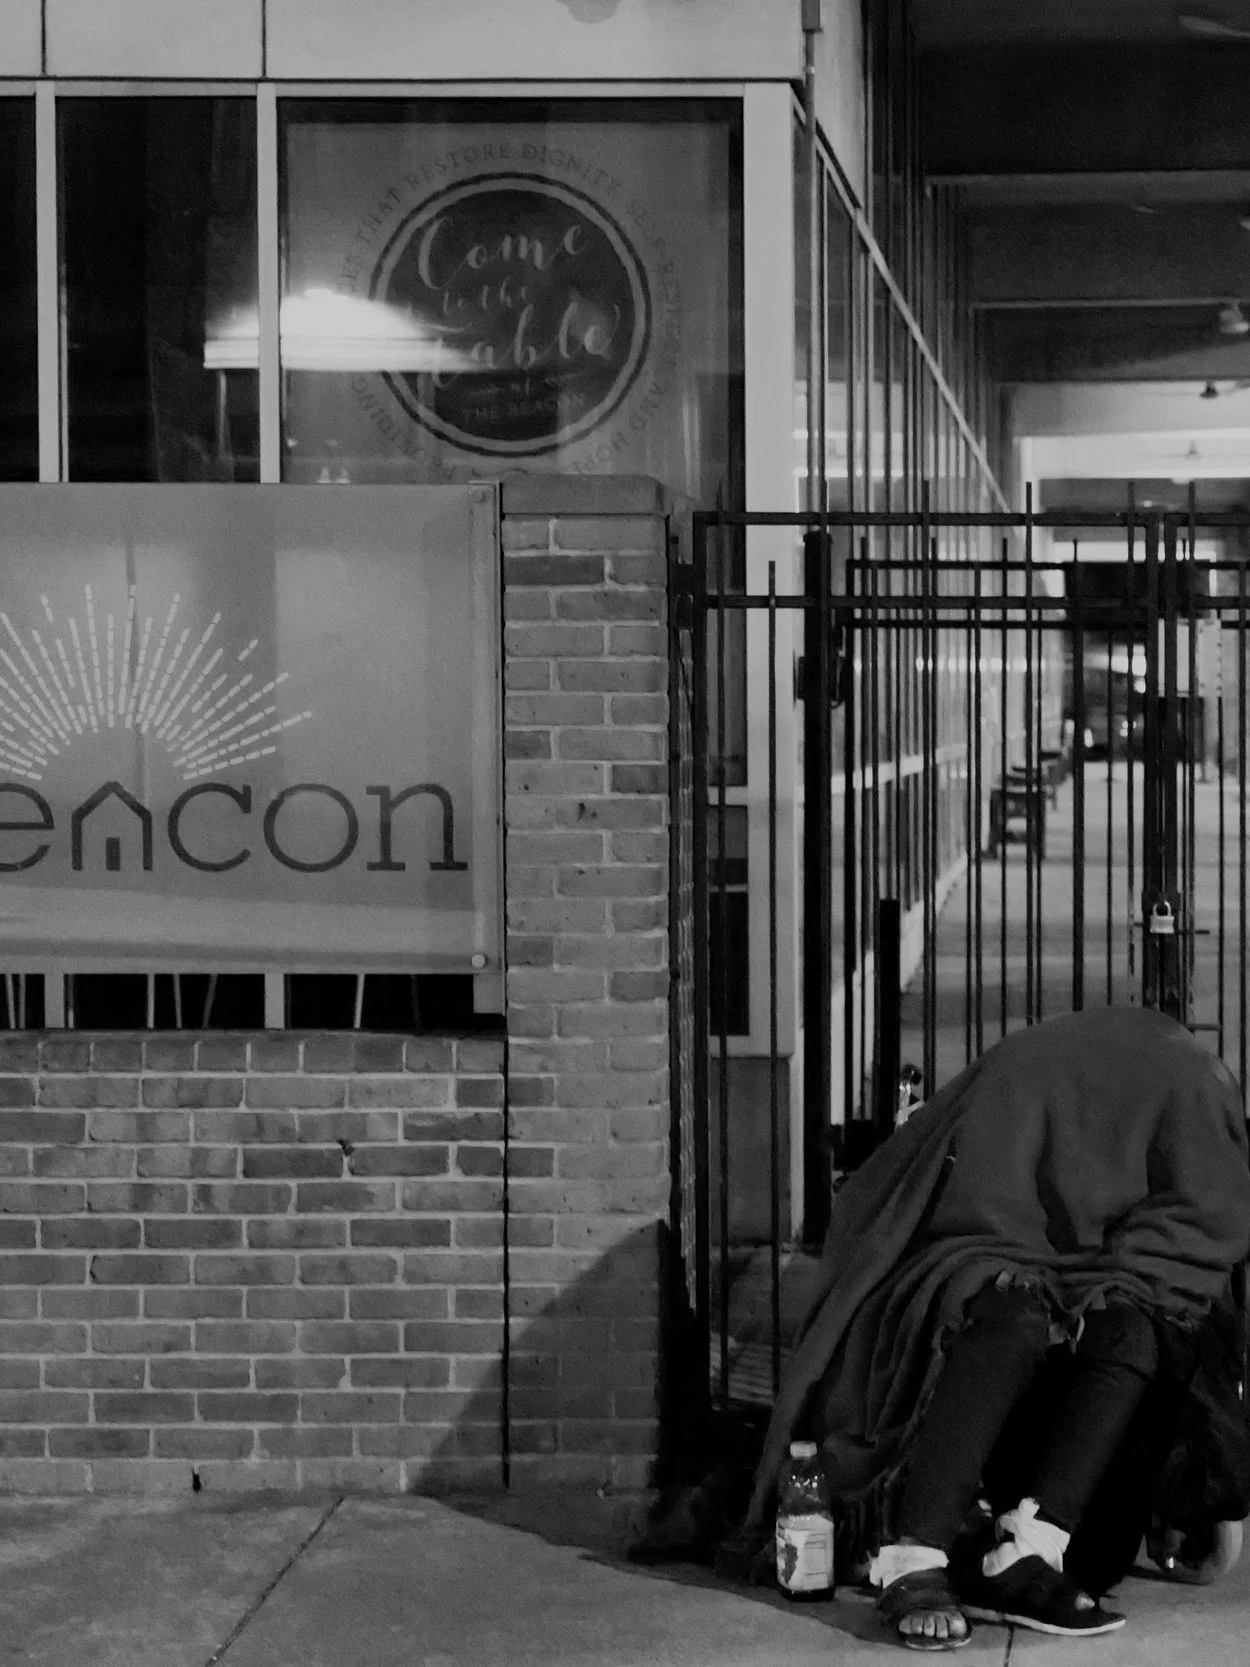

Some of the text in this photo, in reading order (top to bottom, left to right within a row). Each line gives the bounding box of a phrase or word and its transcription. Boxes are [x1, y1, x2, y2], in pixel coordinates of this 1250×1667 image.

[353, 187, 403, 246] THAT
[404, 141, 510, 190] RESTORE
[624, 379, 669, 434] AND
[418, 215, 590, 290] Come
[462, 405, 499, 424] THE
